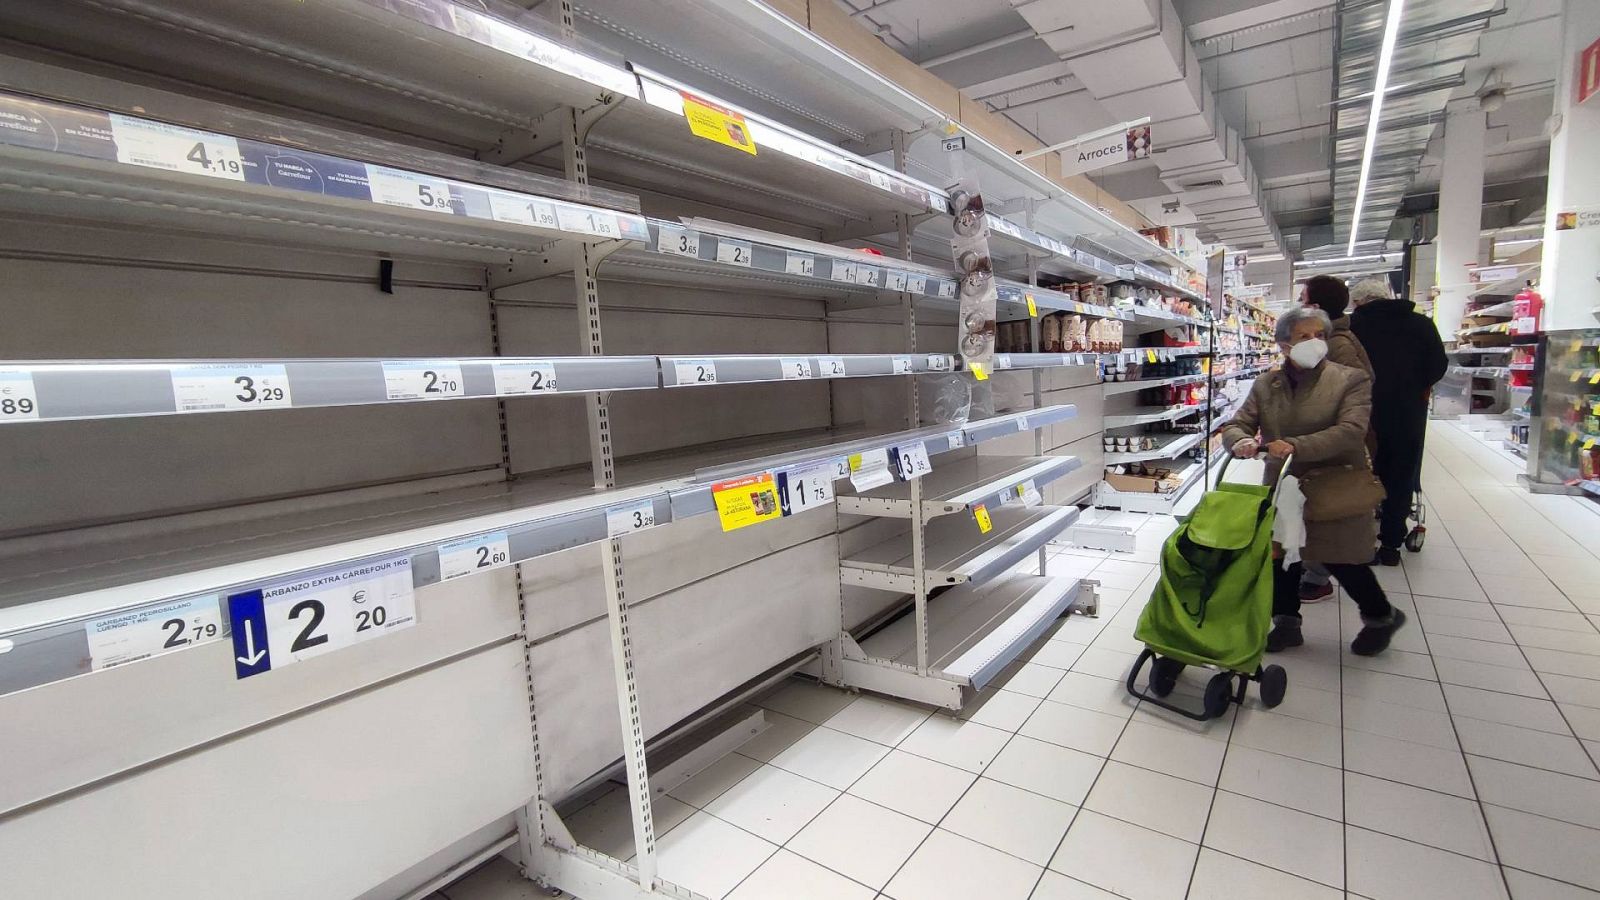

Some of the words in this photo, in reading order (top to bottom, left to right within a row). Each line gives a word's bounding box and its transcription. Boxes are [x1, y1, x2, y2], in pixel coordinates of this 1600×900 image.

[186, 142, 240, 174] 4,19
[1078, 143, 1124, 163] Arroces
[278, 169, 311, 181] Carrefour
[418, 184, 454, 209] 5,94
[526, 203, 554, 225] 1,99
[679, 235, 697, 255] 3,65
[423, 370, 457, 394] 2,70
[530, 370, 557, 391] 2,49
[696, 366, 715, 382] 2,95
[234, 375, 284, 403] 3,29
[1, 398, 33, 415] 89
[903, 453, 914, 475] 3
[796, 479, 806, 506] 1
[813, 487, 825, 501] 75
[632, 511, 654, 529] 3,29
[476, 546, 506, 568] 2,60
[261, 581, 311, 600] ARBANZO
[311, 575, 342, 588] EXTRA
[342, 561, 393, 580] CARREFOUR
[393, 557, 409, 568] 1KG
[352, 590, 368, 604] €
[161, 618, 218, 650] 2,79
[287, 599, 329, 654] 2
[355, 605, 387, 633] 20
